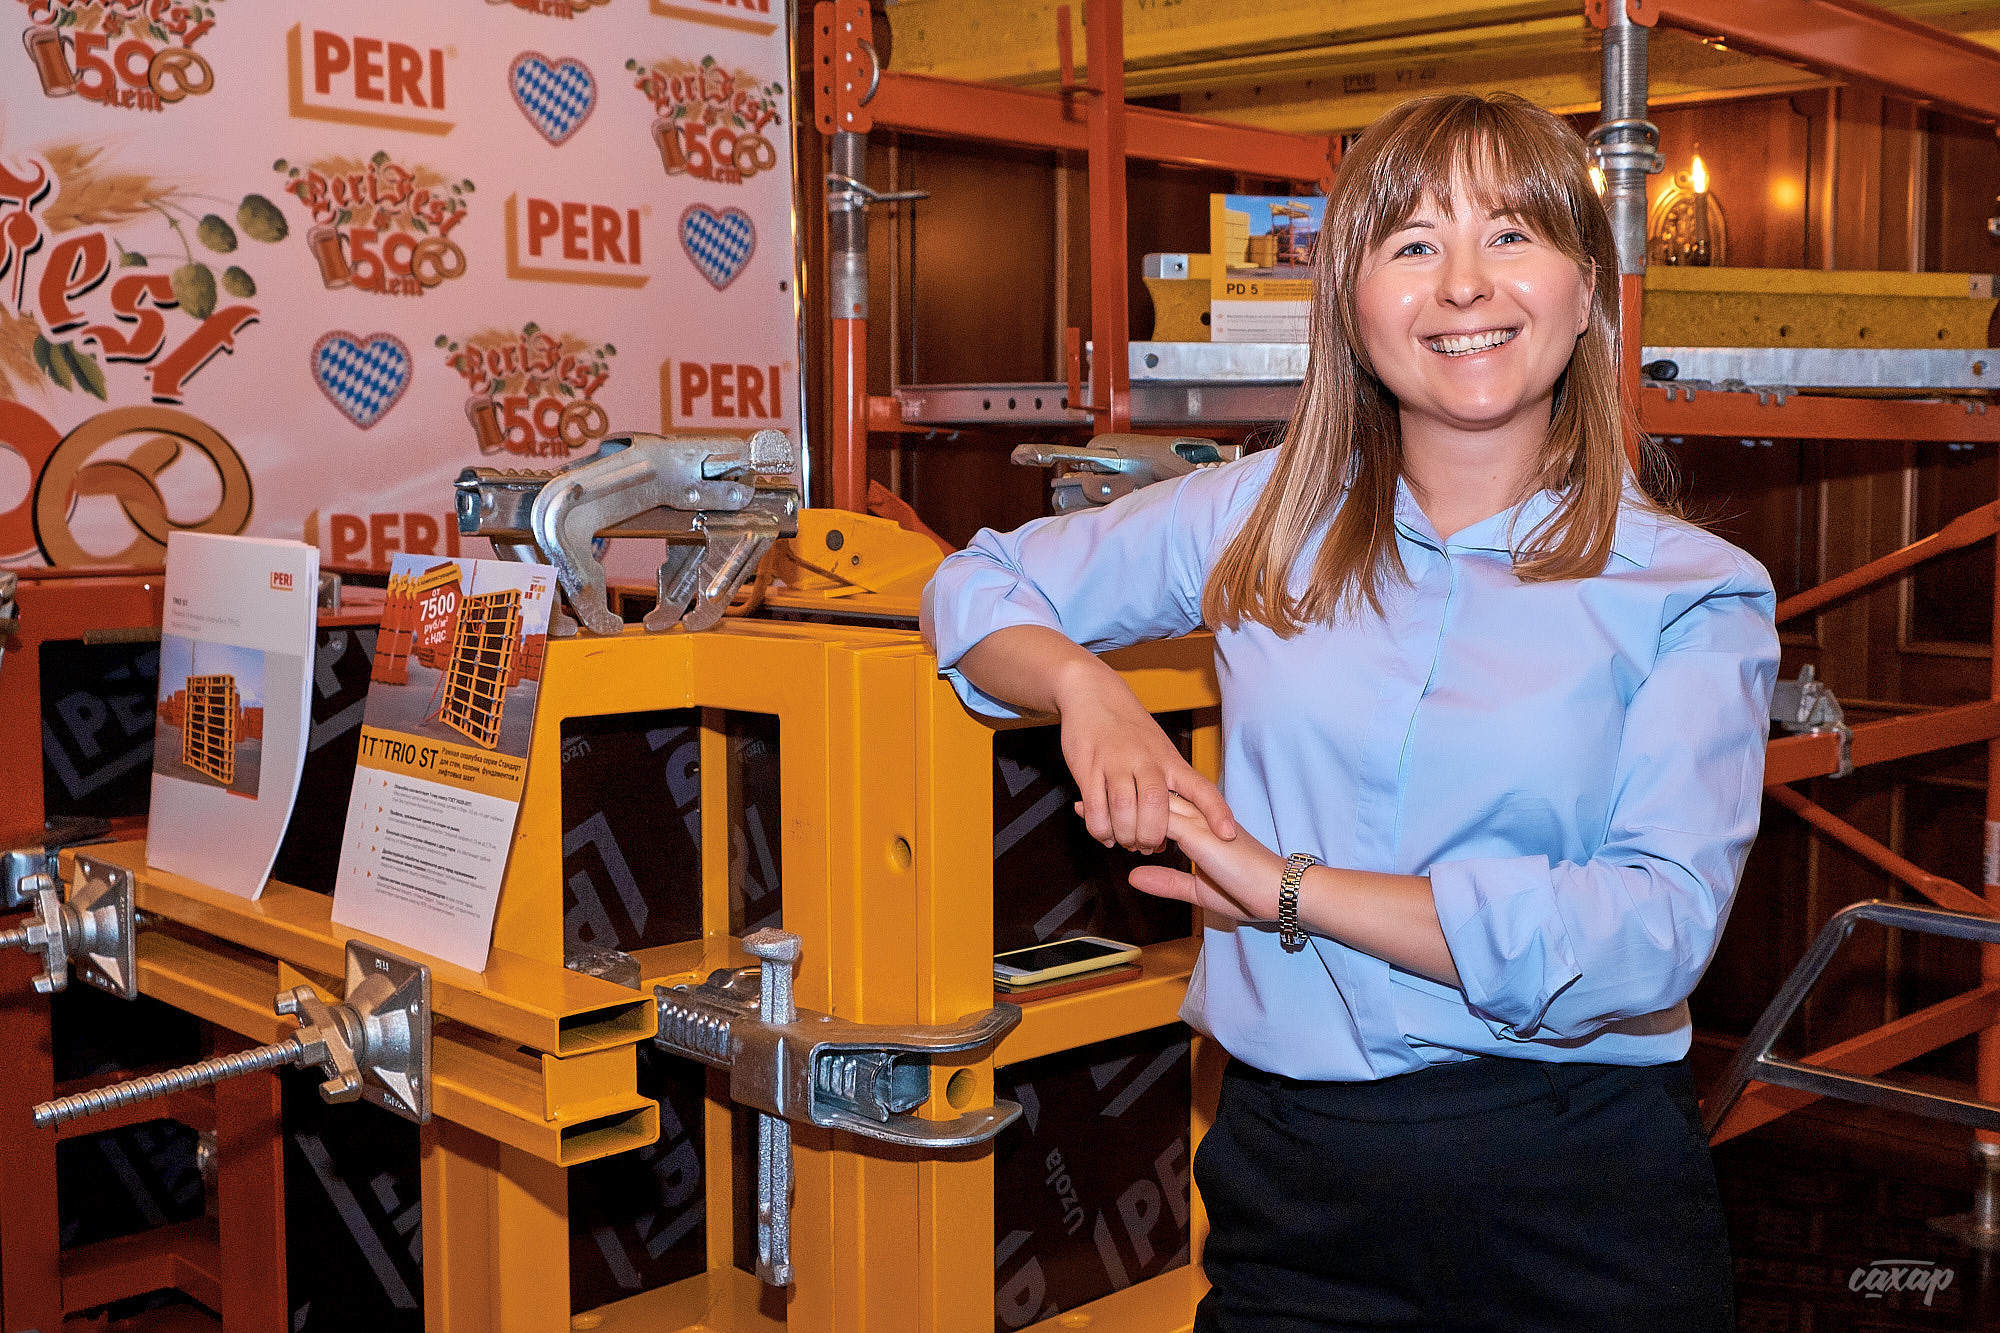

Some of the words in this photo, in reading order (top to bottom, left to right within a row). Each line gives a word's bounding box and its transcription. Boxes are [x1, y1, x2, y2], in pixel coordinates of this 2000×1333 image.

[313, 29, 446, 110] PERI
[527, 198, 642, 265] PERI
[1226, 283, 1246, 295] PD
[1250, 283, 1258, 295] 5
[679, 360, 783, 419] PERI
[273, 571, 293, 587] PERI
[420, 592, 456, 622] 7500
[430, 631, 447, 645] НДС
[419, 747, 439, 770] ST
